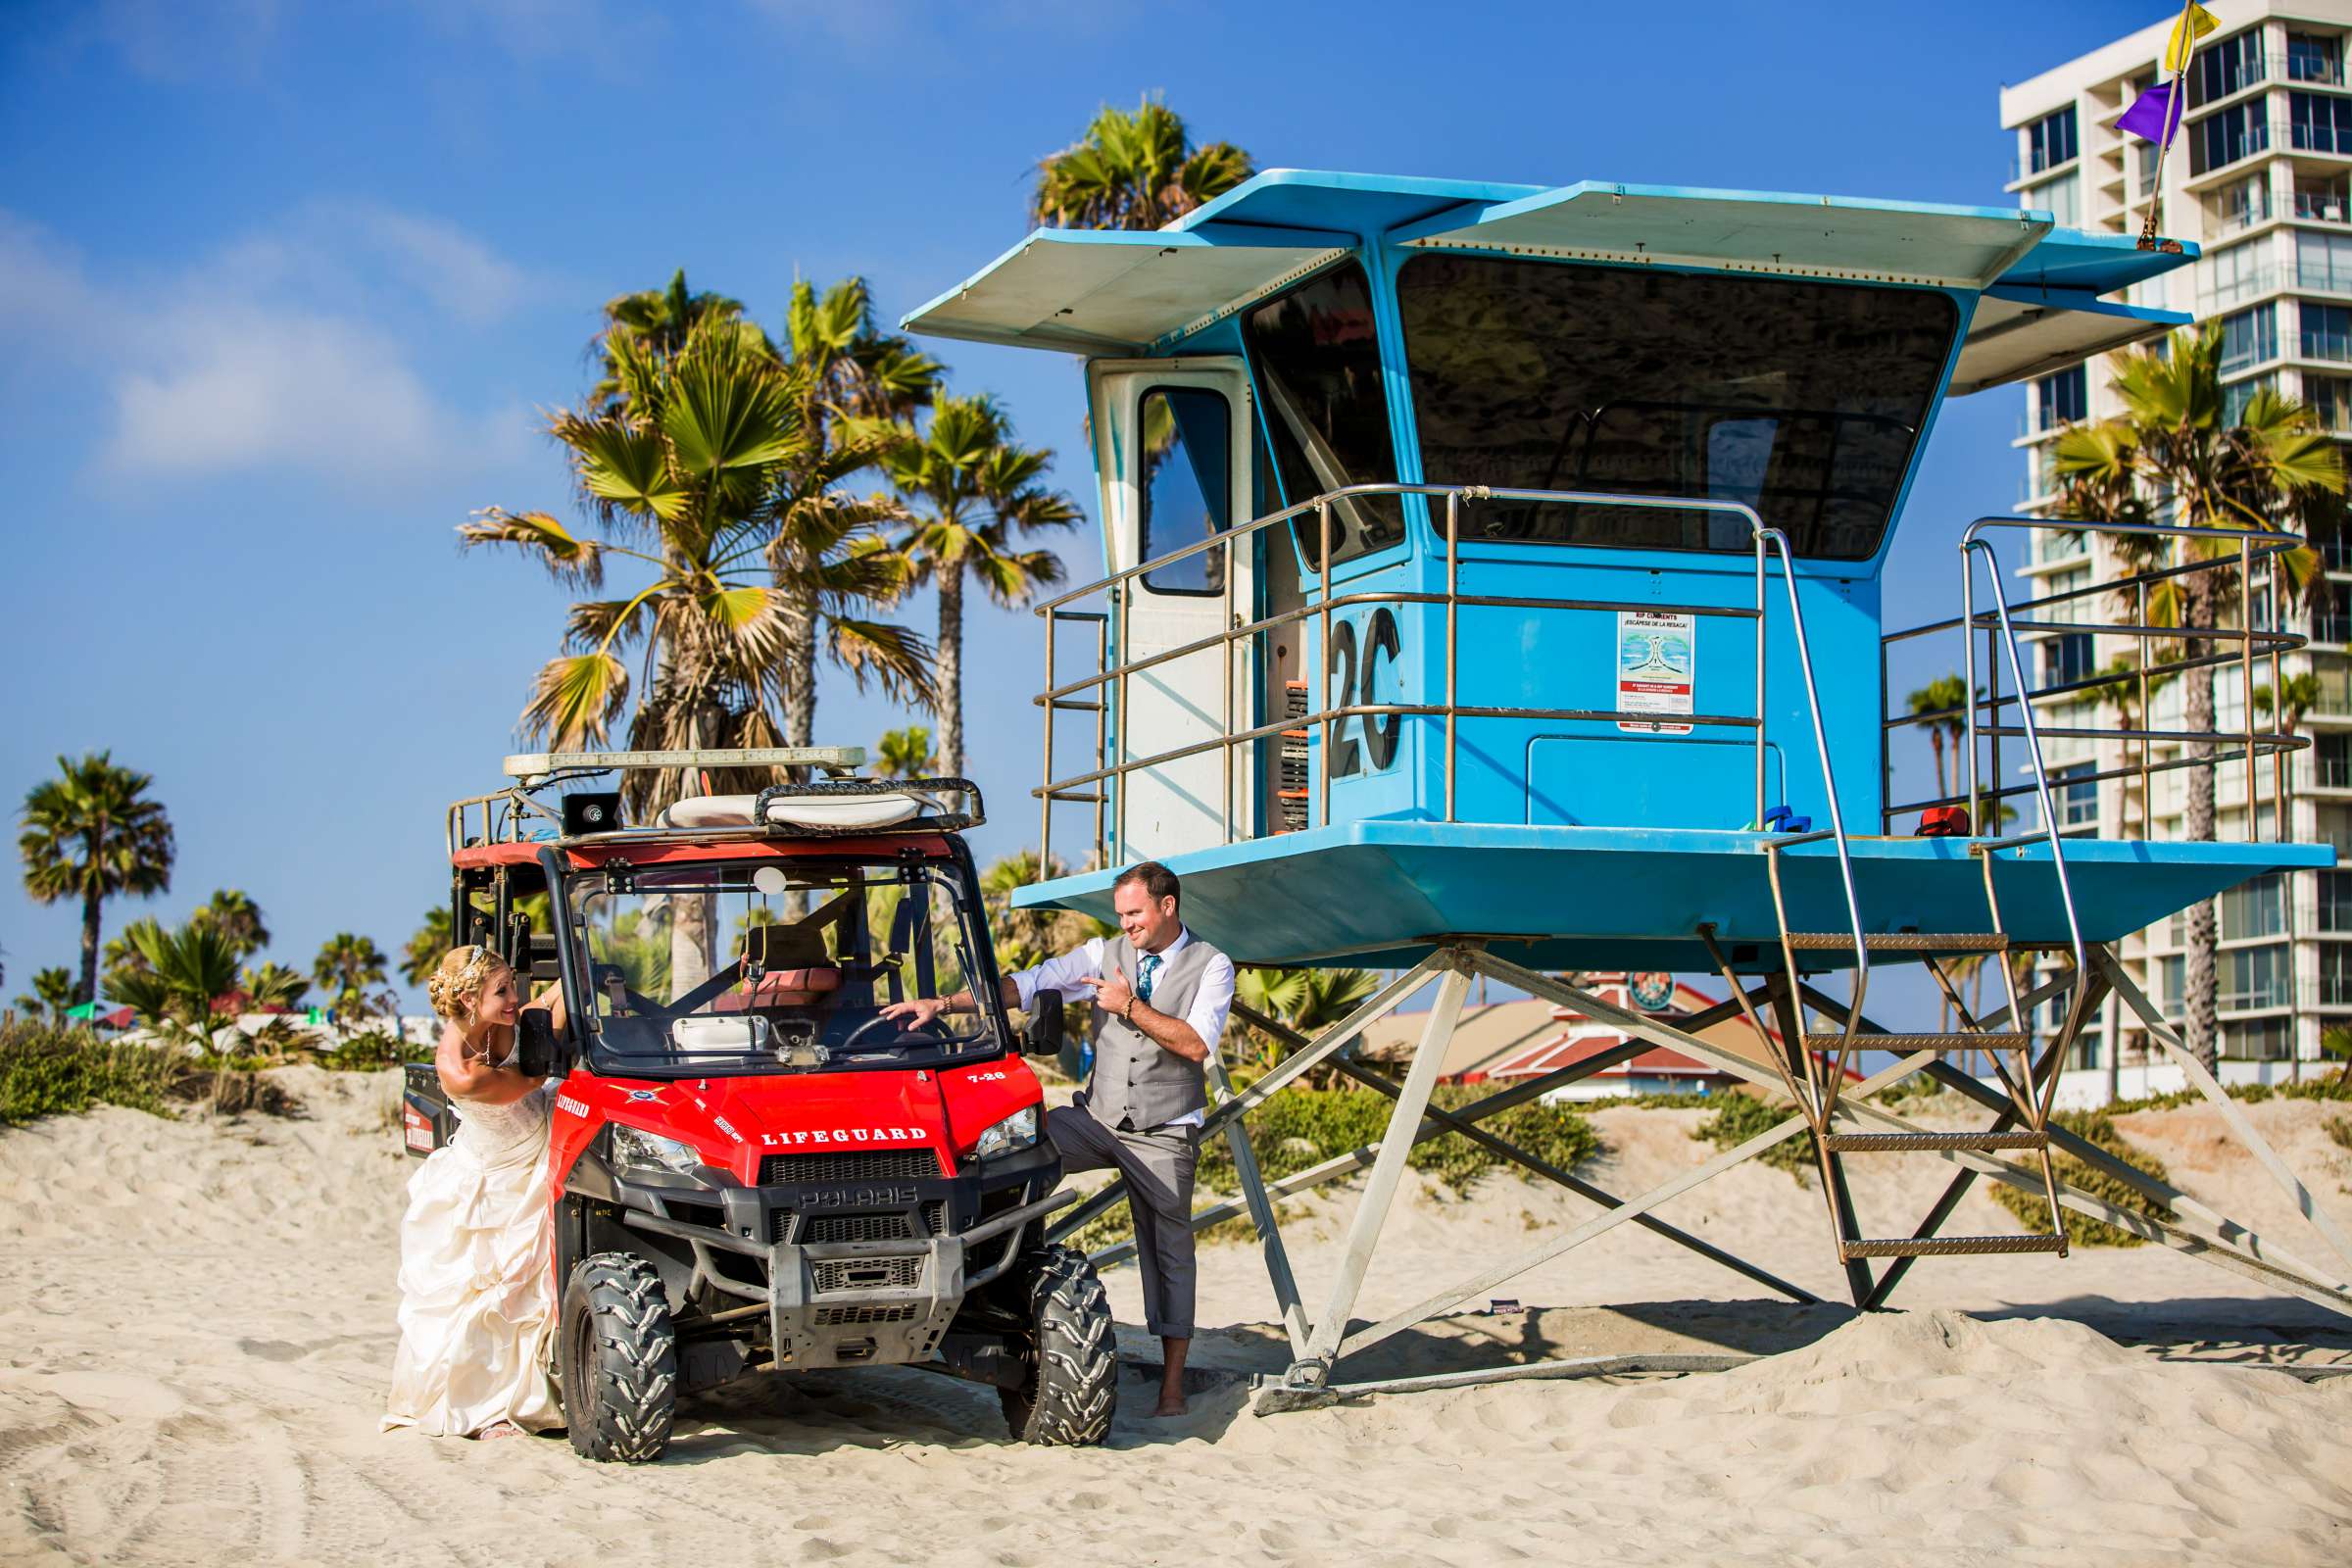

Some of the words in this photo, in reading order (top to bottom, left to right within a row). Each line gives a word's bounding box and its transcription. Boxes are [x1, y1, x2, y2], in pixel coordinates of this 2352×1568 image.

[967, 1071, 1006, 1084] 7-26
[557, 1094, 590, 1118] LIFEGUARD
[761, 1128, 927, 1146] LIFEGUARD
[800, 1185, 918, 1208] POLARIS
